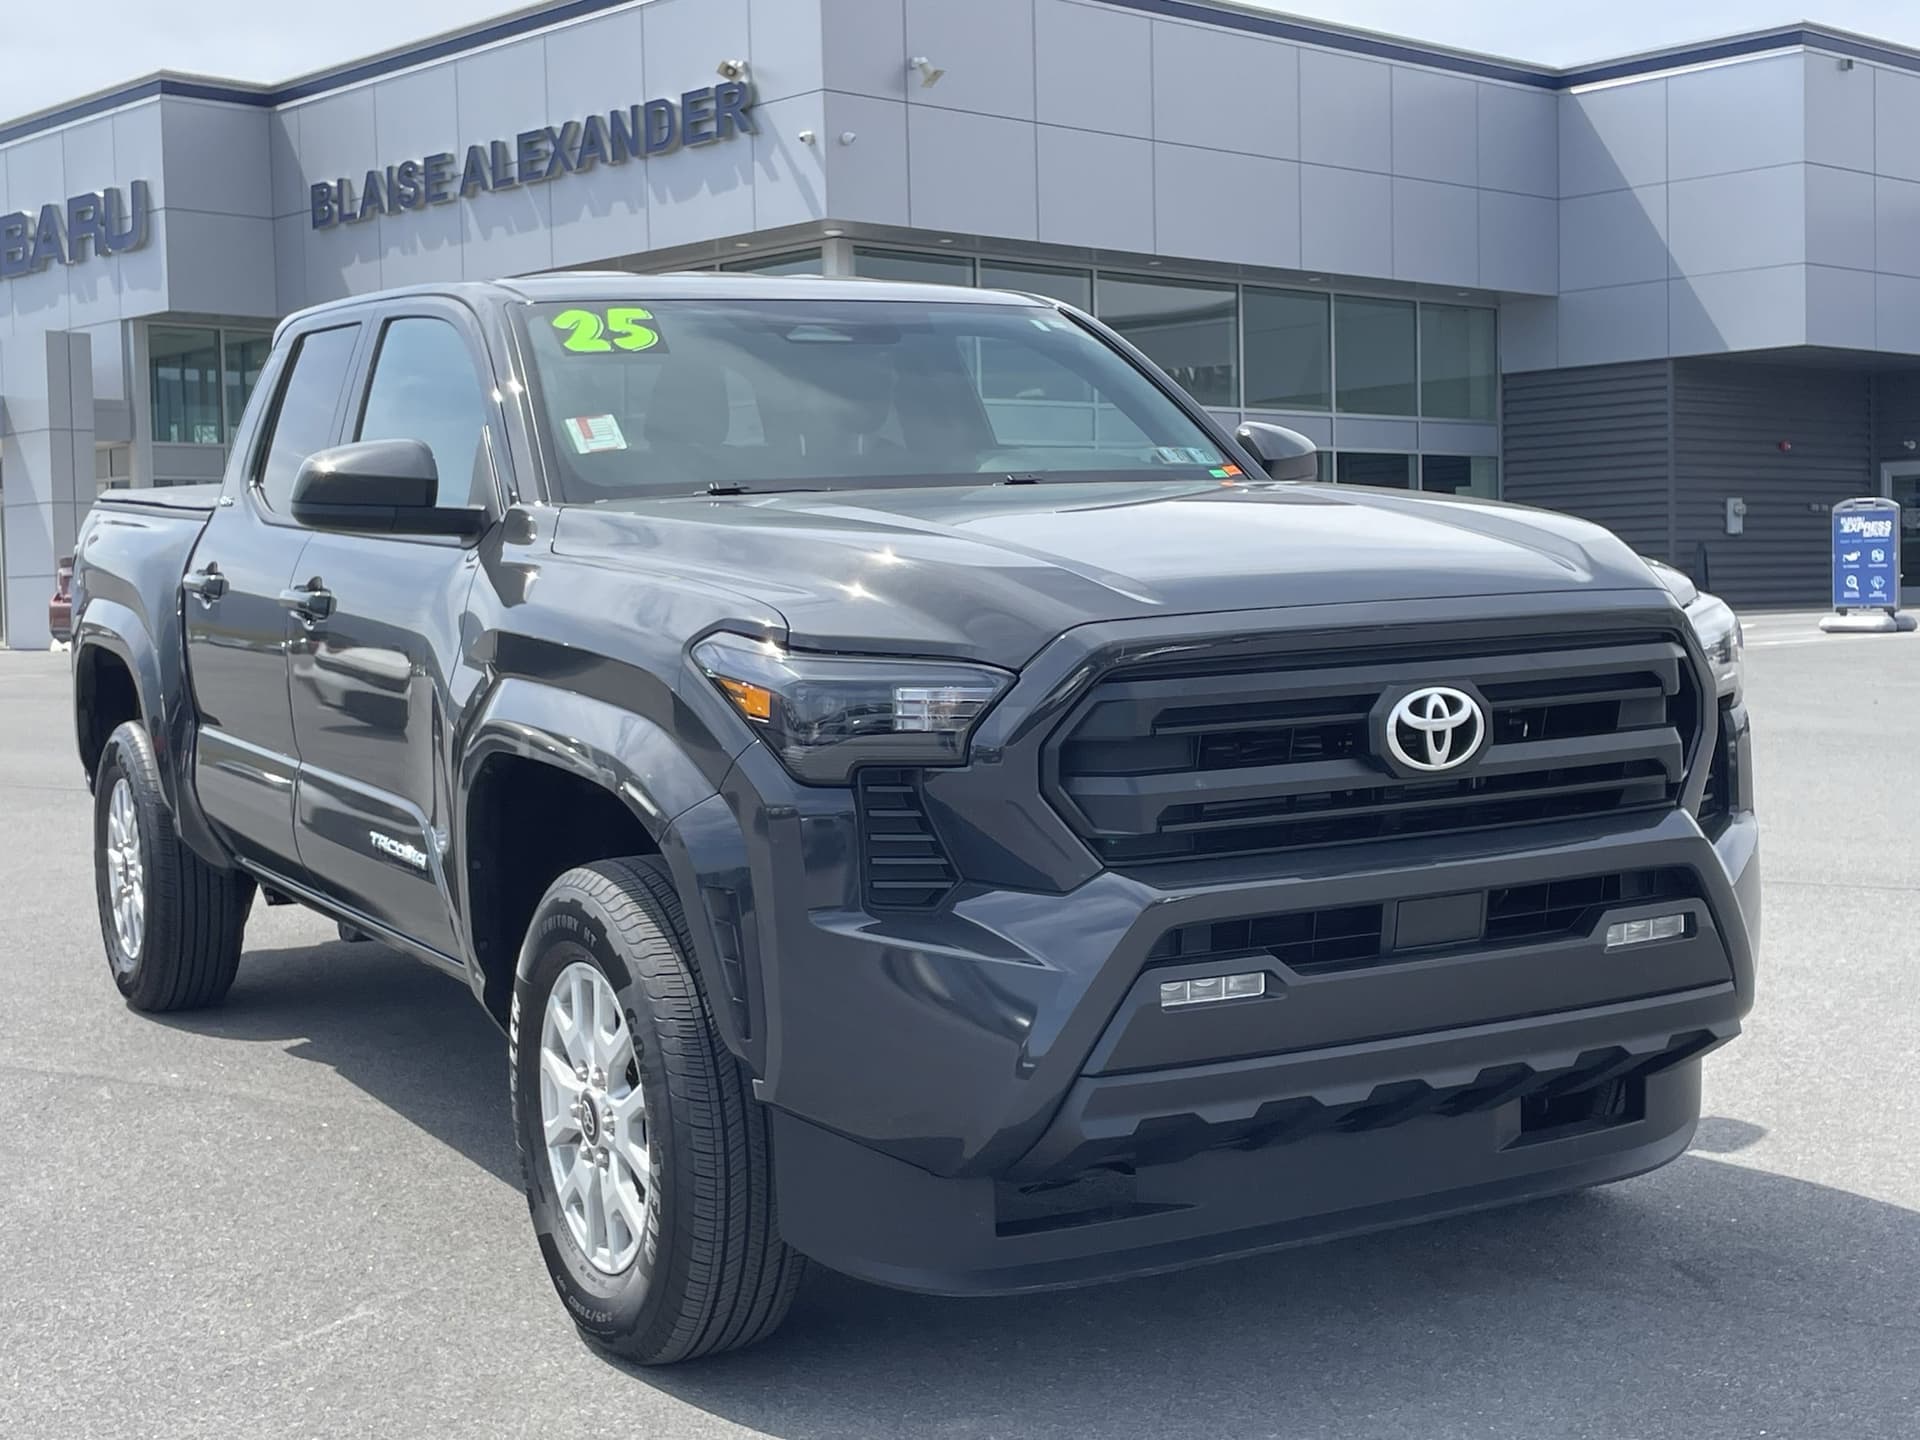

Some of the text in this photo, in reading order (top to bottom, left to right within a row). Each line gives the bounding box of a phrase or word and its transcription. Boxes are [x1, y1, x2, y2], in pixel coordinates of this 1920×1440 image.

[311, 80, 758, 230] BLAISE ALEXANDER
[0, 179, 150, 280] BARU
[552, 307, 660, 352] 25
